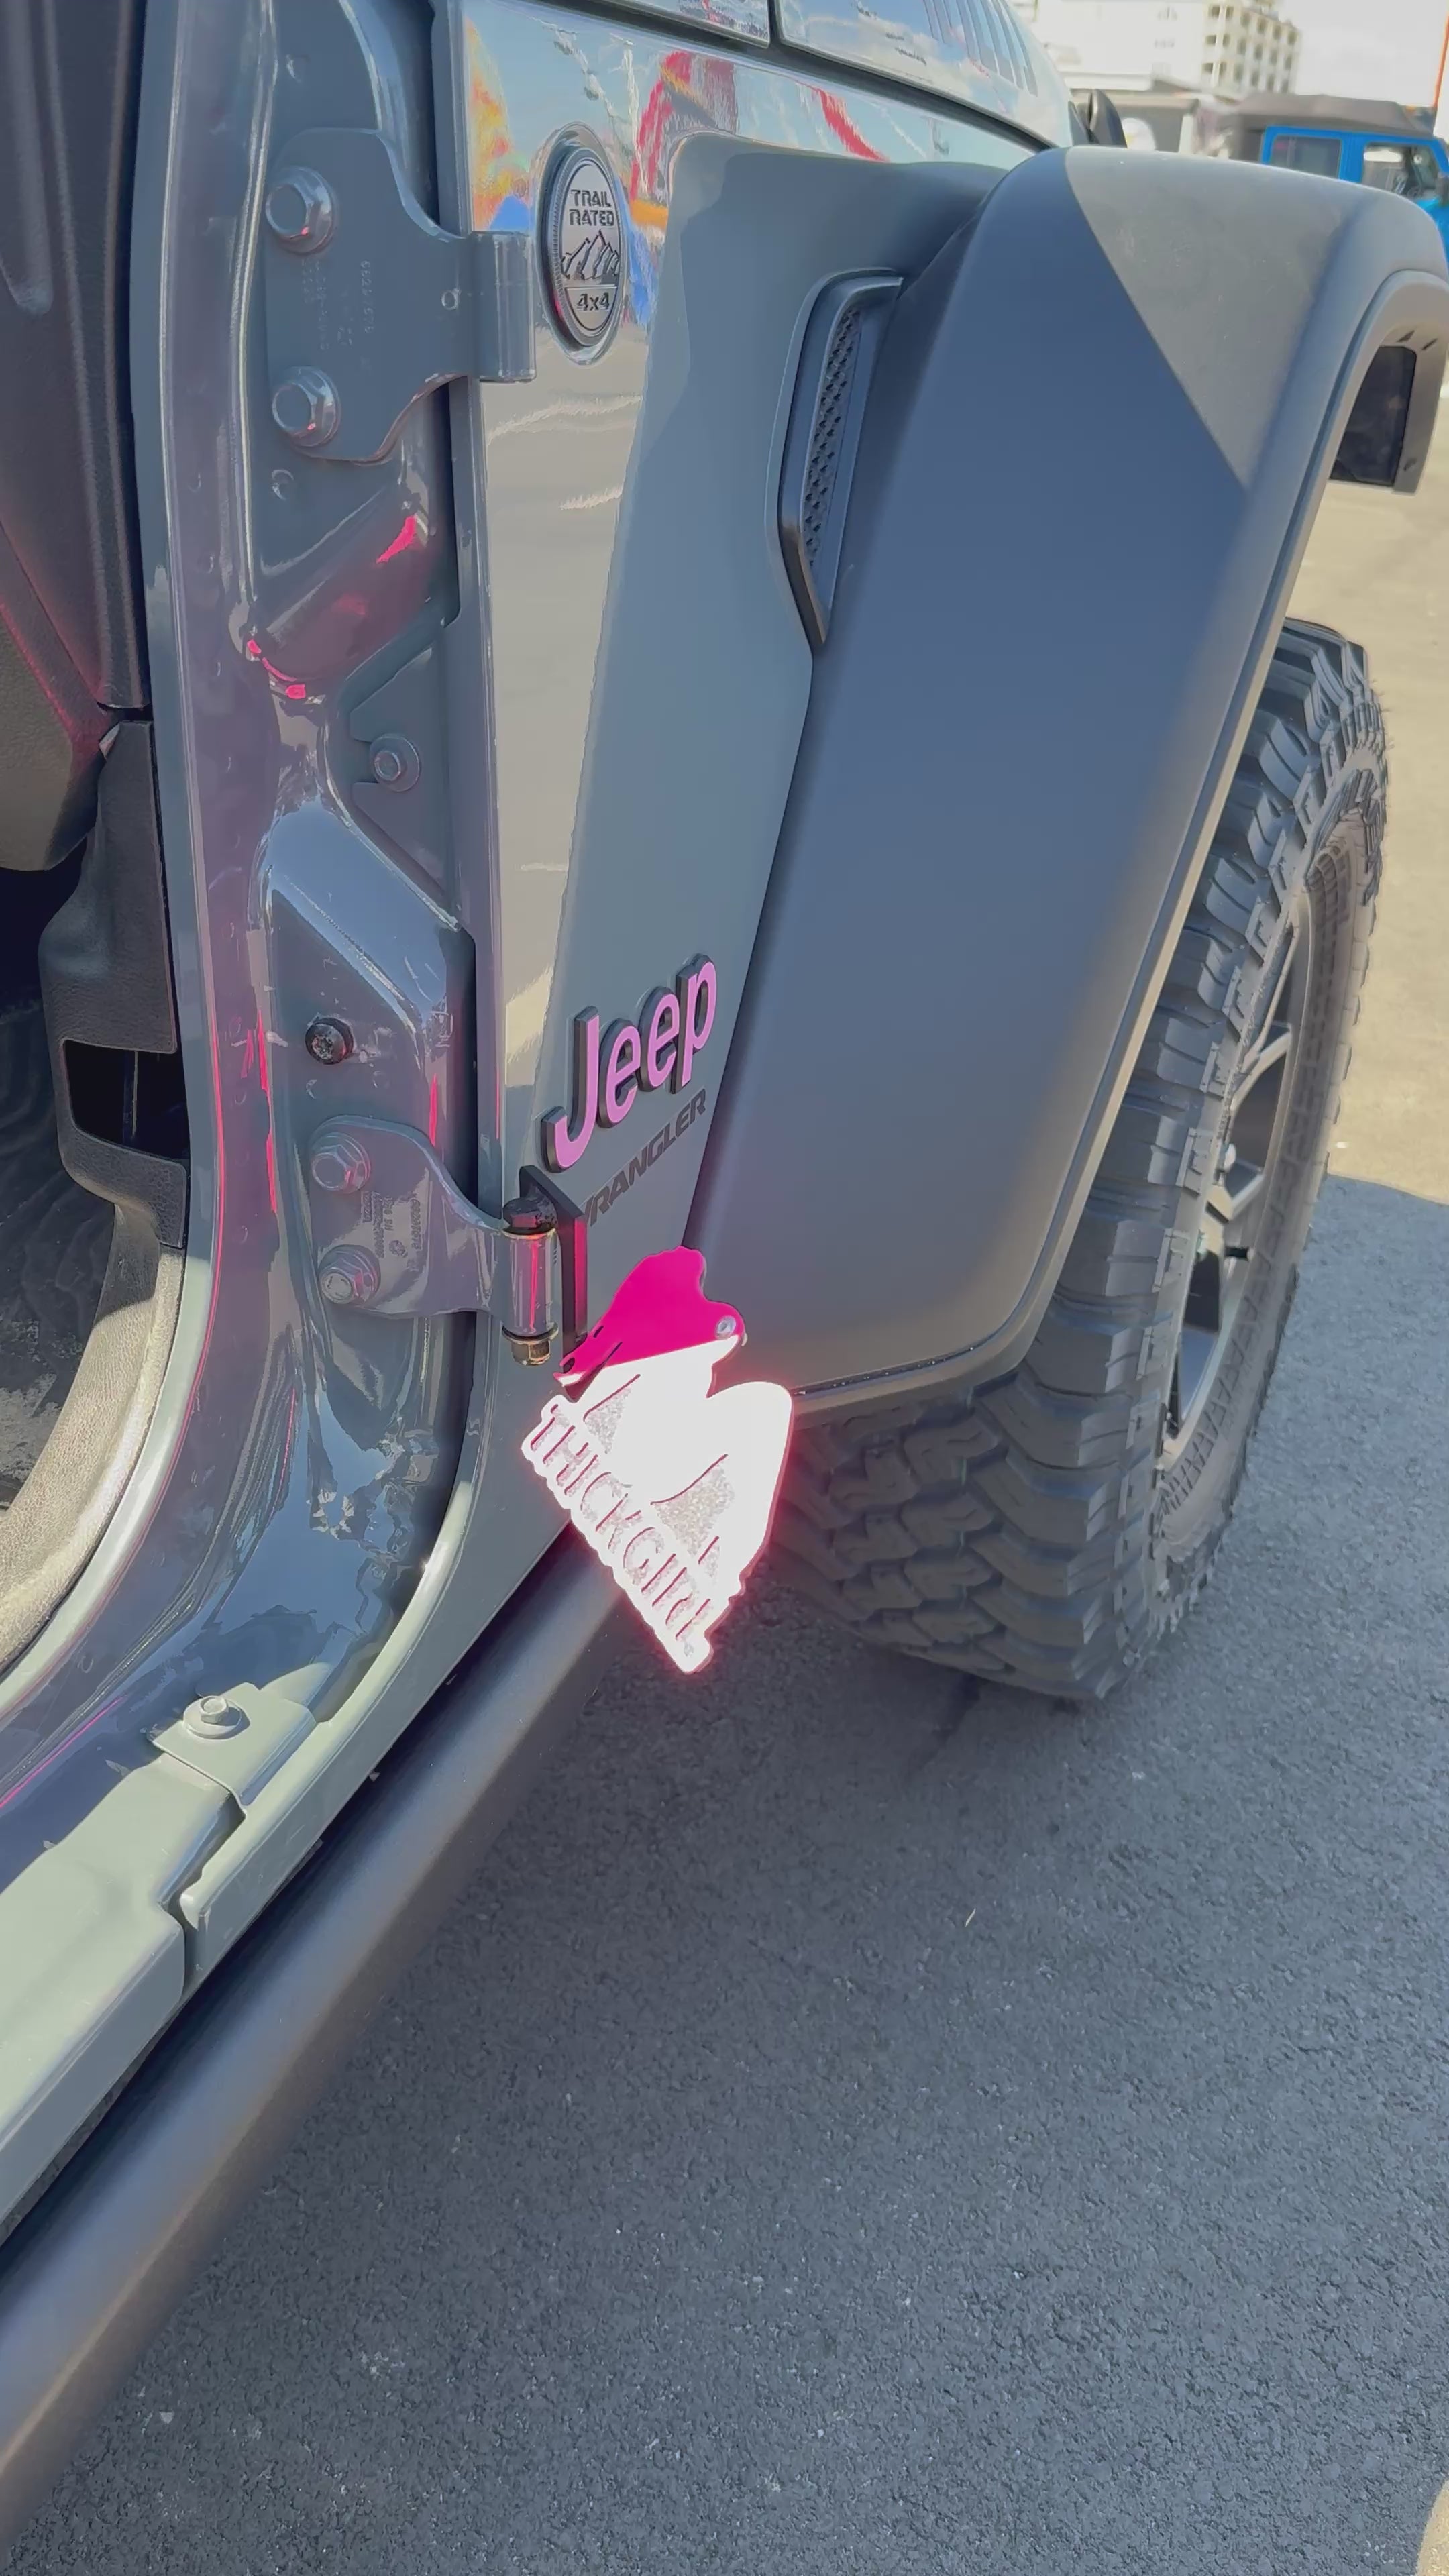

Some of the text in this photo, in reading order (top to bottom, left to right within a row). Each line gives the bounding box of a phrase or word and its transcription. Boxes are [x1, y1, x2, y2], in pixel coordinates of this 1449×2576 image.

[570, 189, 612, 207] TRAIL
[569, 209, 614, 227] RATED
[576, 292, 610, 311] 4x4
[542, 953, 717, 1173] Jeep
[529, 1403, 712, 1658] THICKGIRL
